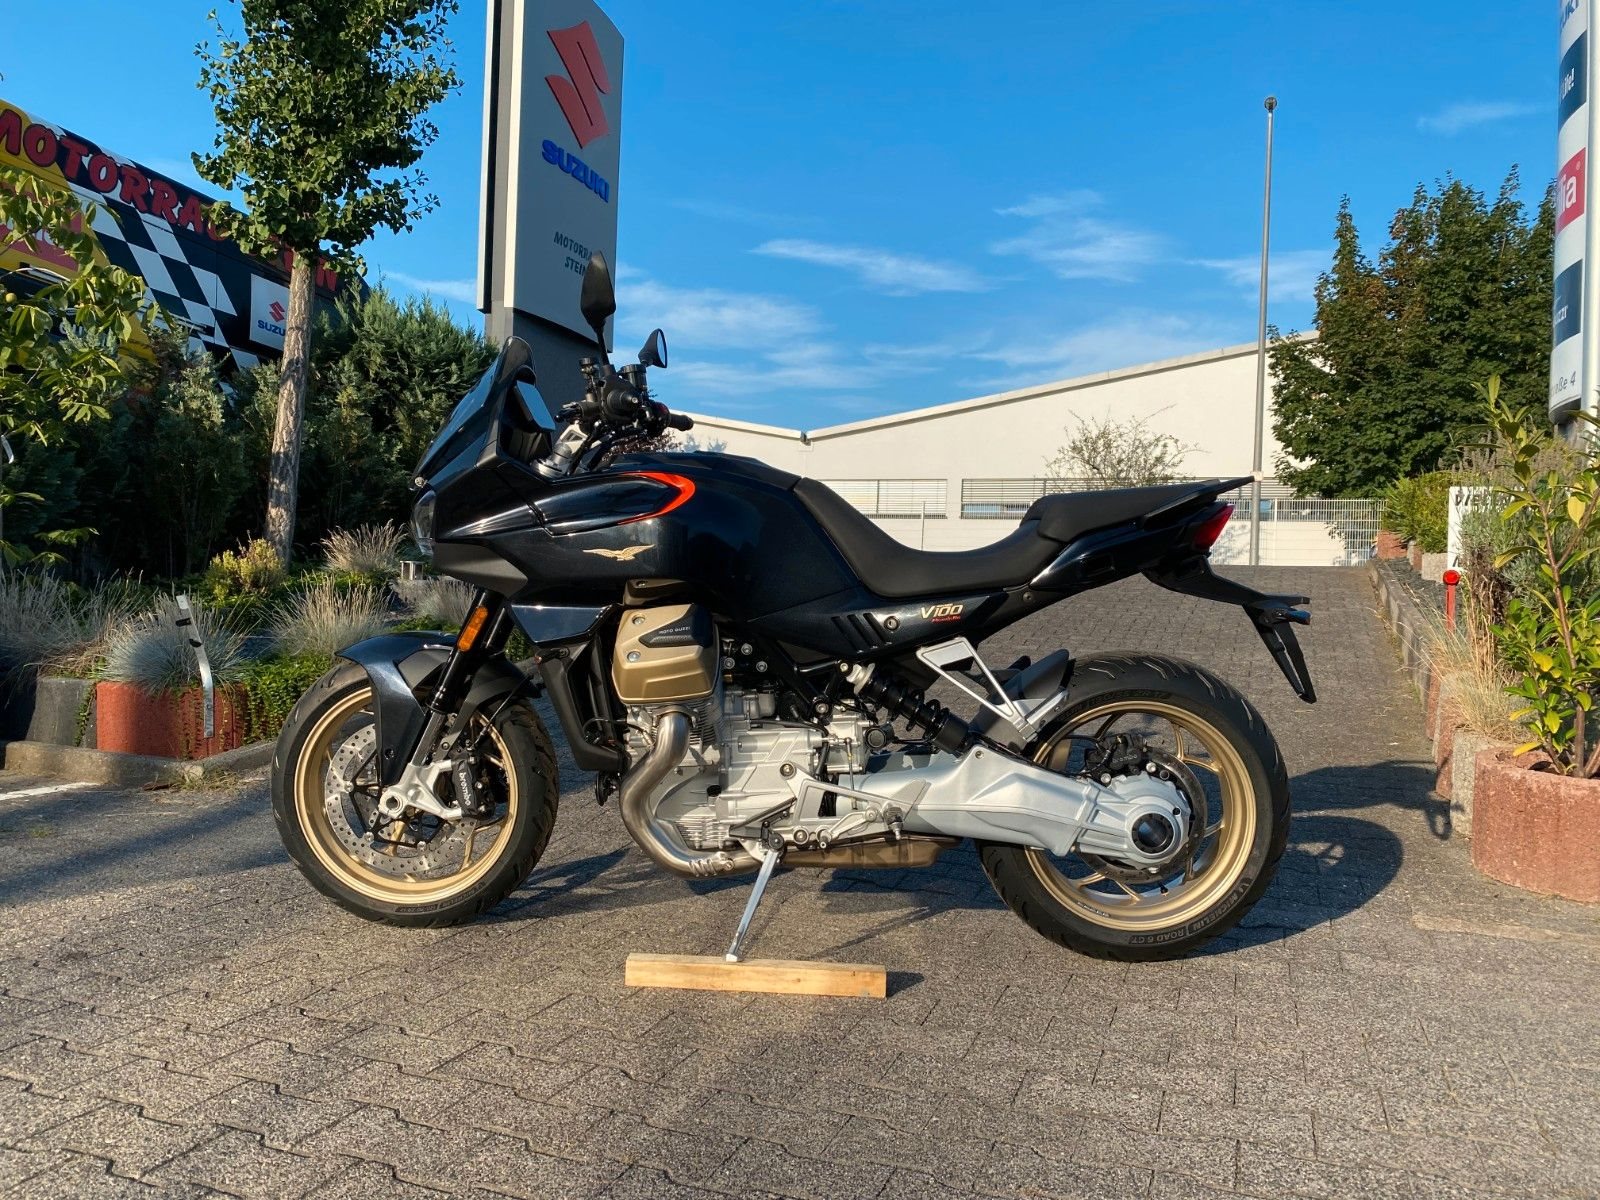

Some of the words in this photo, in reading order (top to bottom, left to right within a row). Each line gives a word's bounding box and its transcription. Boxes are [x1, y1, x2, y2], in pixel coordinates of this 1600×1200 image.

[542, 139, 610, 203] SUZUKI
[257, 319, 286, 337] SUZU
[459, 772, 472, 806] brembo
[1192, 892, 1239, 932] MICHELIN
[1156, 928, 1185, 944] ROAD
